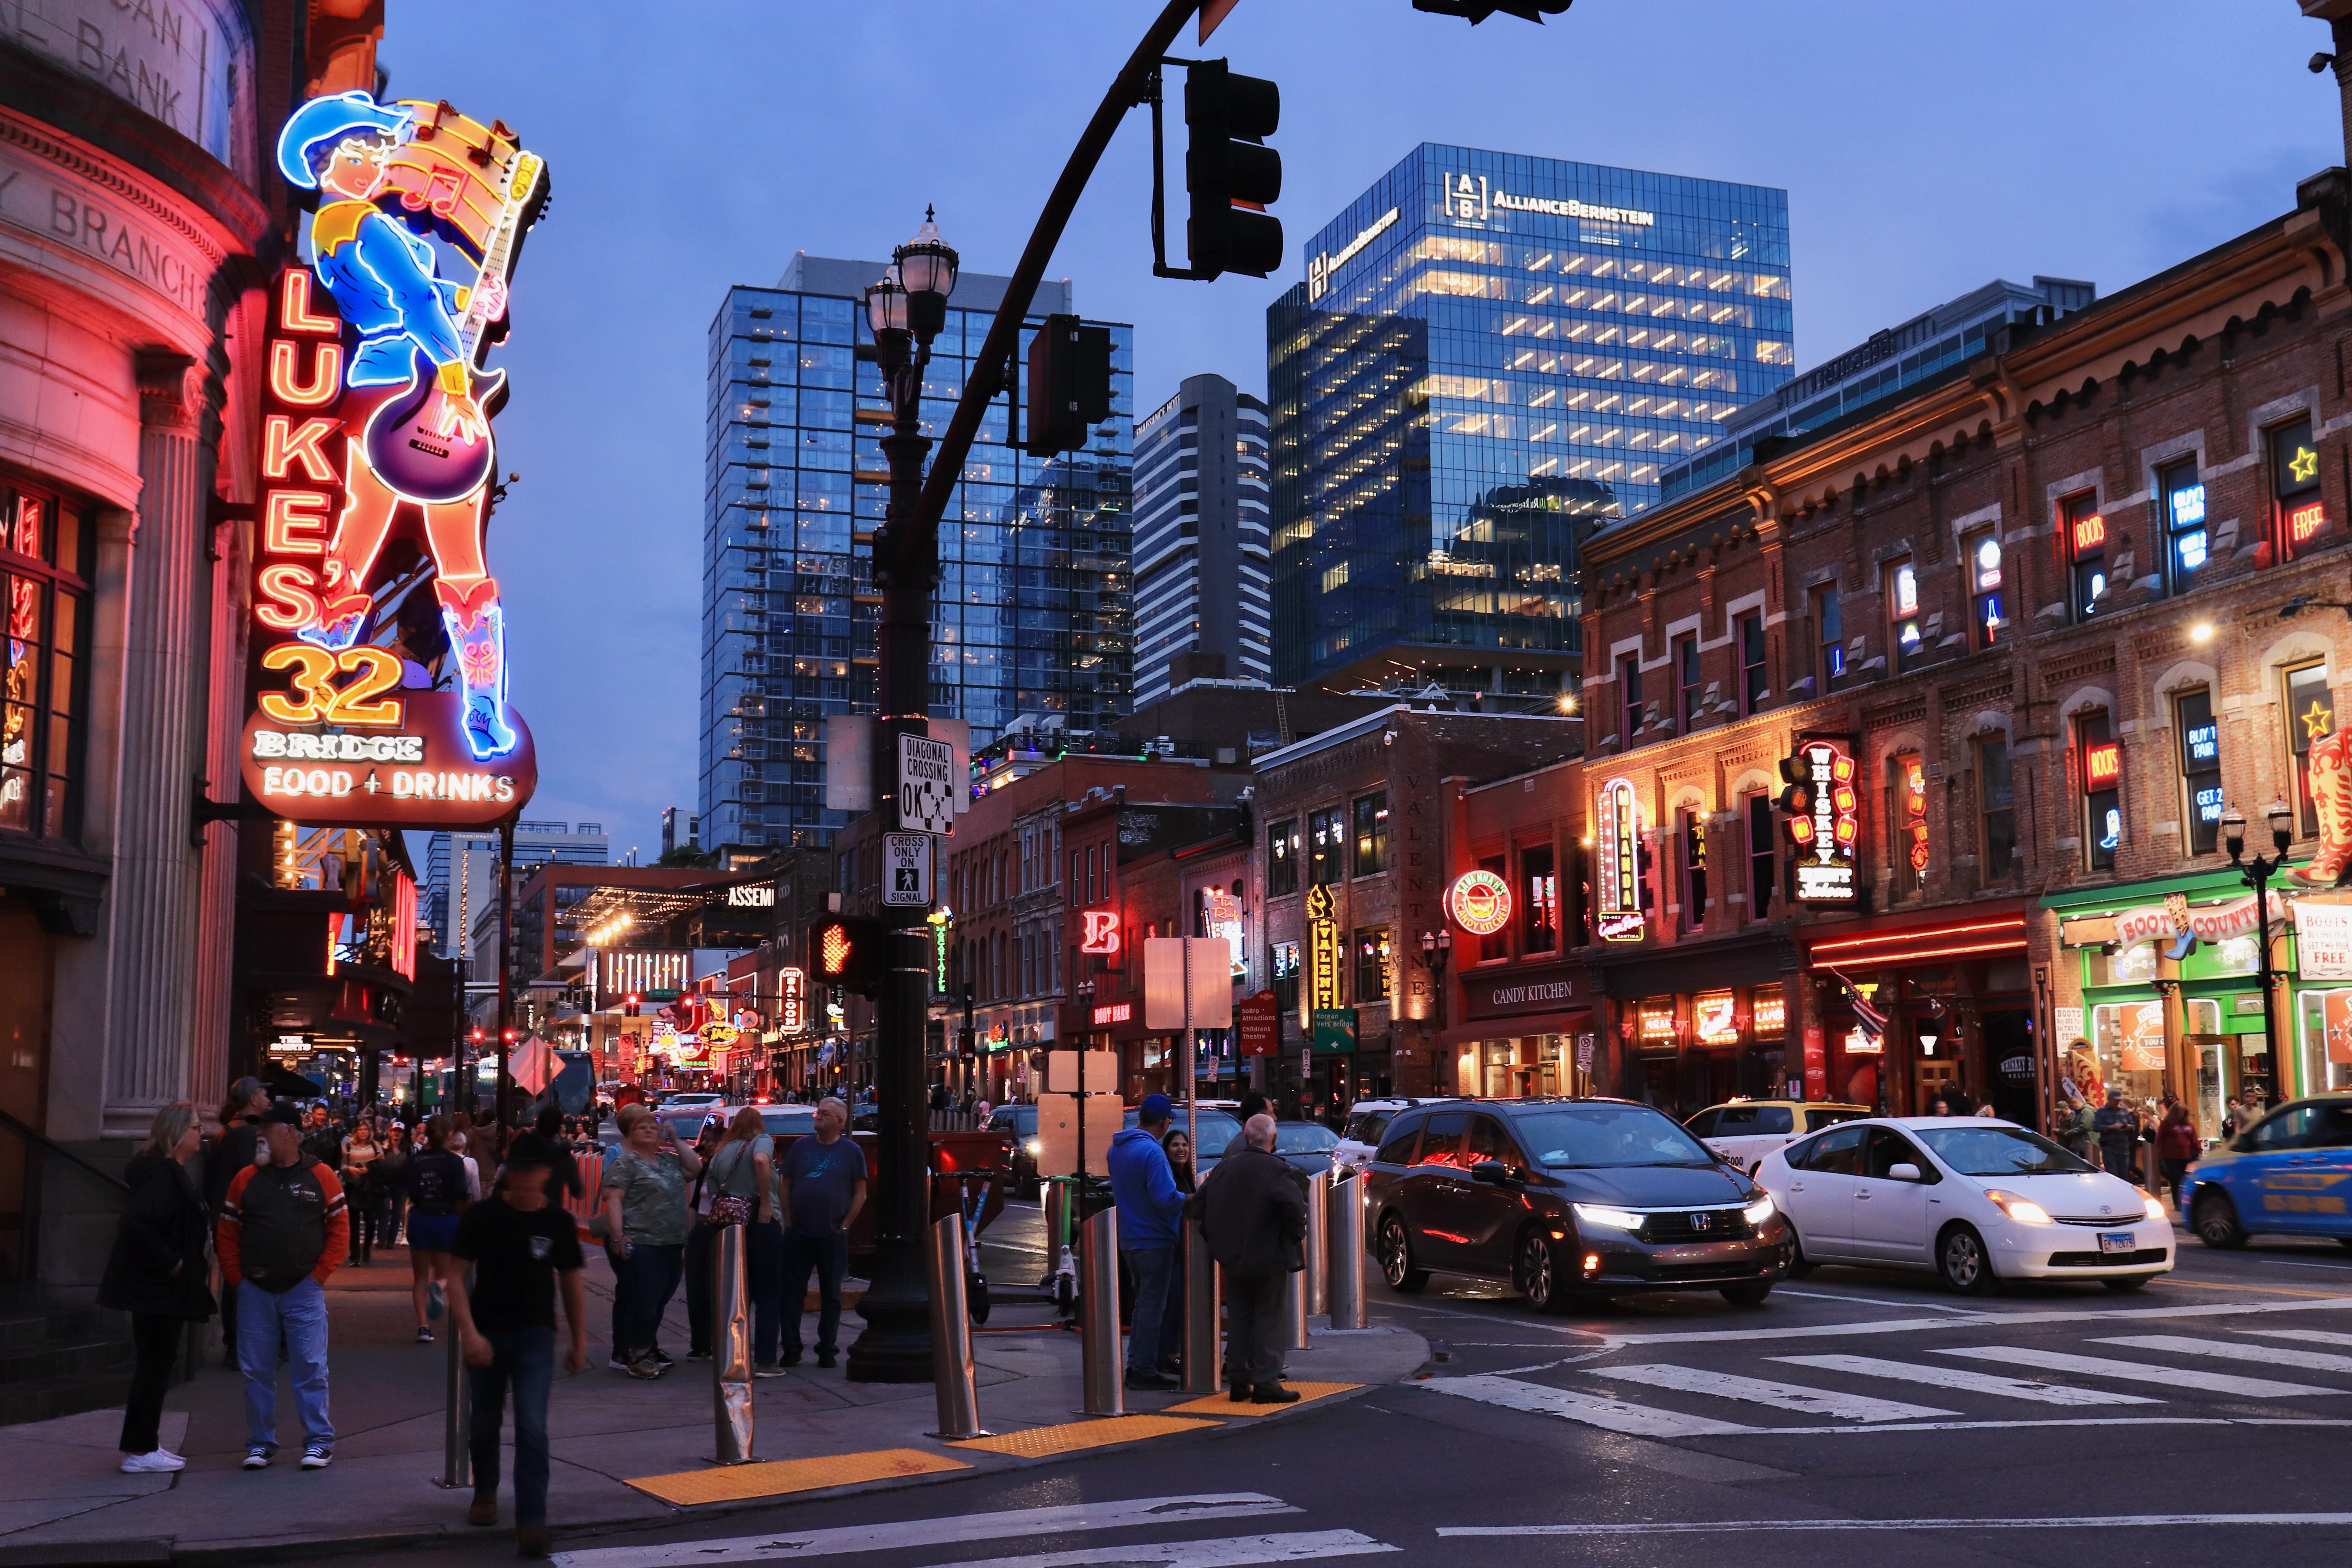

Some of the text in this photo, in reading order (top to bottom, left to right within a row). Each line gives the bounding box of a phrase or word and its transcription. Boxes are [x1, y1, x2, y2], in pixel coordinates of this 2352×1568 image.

[77, 18, 181, 130] BANK
[1458, 174, 1474, 193] A
[1459, 201, 1474, 219] B
[50, 190, 194, 310] BRANCH
[254, 268, 349, 631] LUKE'S
[2077, 516, 2105, 548] BOOTS
[258, 642, 405, 728] 32
[2189, 726, 2216, 744] BUY 1
[253, 731, 423, 761] BRIDGE
[907, 739, 948, 763] DIAGONAL
[2194, 742, 2215, 759] PAIR
[908, 758, 947, 782] CROSSING
[1836, 762, 1850, 778] WB
[2091, 744, 2119, 778] BOOTS
[263, 767, 352, 795] FOOD
[392, 771, 515, 802] DRINKS
[903, 782, 923, 818] OK
[1838, 792, 1853, 808] WB
[2197, 788, 2223, 806] GET 2
[1809, 748, 1835, 865] WHISKEY
[2201, 803, 2223, 821] PAIR
[1795, 822, 1810, 838] WB
[1838, 822, 1853, 839] WB
[891, 836, 924, 847] CROSS
[1618, 789, 1632, 906] MIRANDA
[895, 847, 920, 857] ONLY
[901, 858, 914, 867] ON
[1406, 775, 1426, 995] VALENTINE
[1457, 873, 1506, 896] SAVANNAH'S
[1798, 881, 1853, 898] Saloon
[891, 893, 923, 902] SIGNAL
[1212, 896, 1234, 907] Tin
[1212, 907, 1239, 921] Roof
[1455, 904, 1508, 931] CANDY KITCHEN
[2306, 916, 2347, 927] BOOTS
[2122, 914, 2172, 940] BOOT
[2334, 930, 2349, 941] PAIR
[2336, 942, 2350, 952] PAIR
[935, 926, 946, 992] MARGARITAVILLE
[2314, 952, 2346, 964] FREE
[1493, 982, 1572, 1005] CANDY KITCHEN
[1094, 1007, 1111, 1024] BOOT
[2134, 1022, 2147, 1038] BUY
[2000, 1056, 2025, 1073] WHISKEY
[2135, 1049, 2150, 1063] TWO
